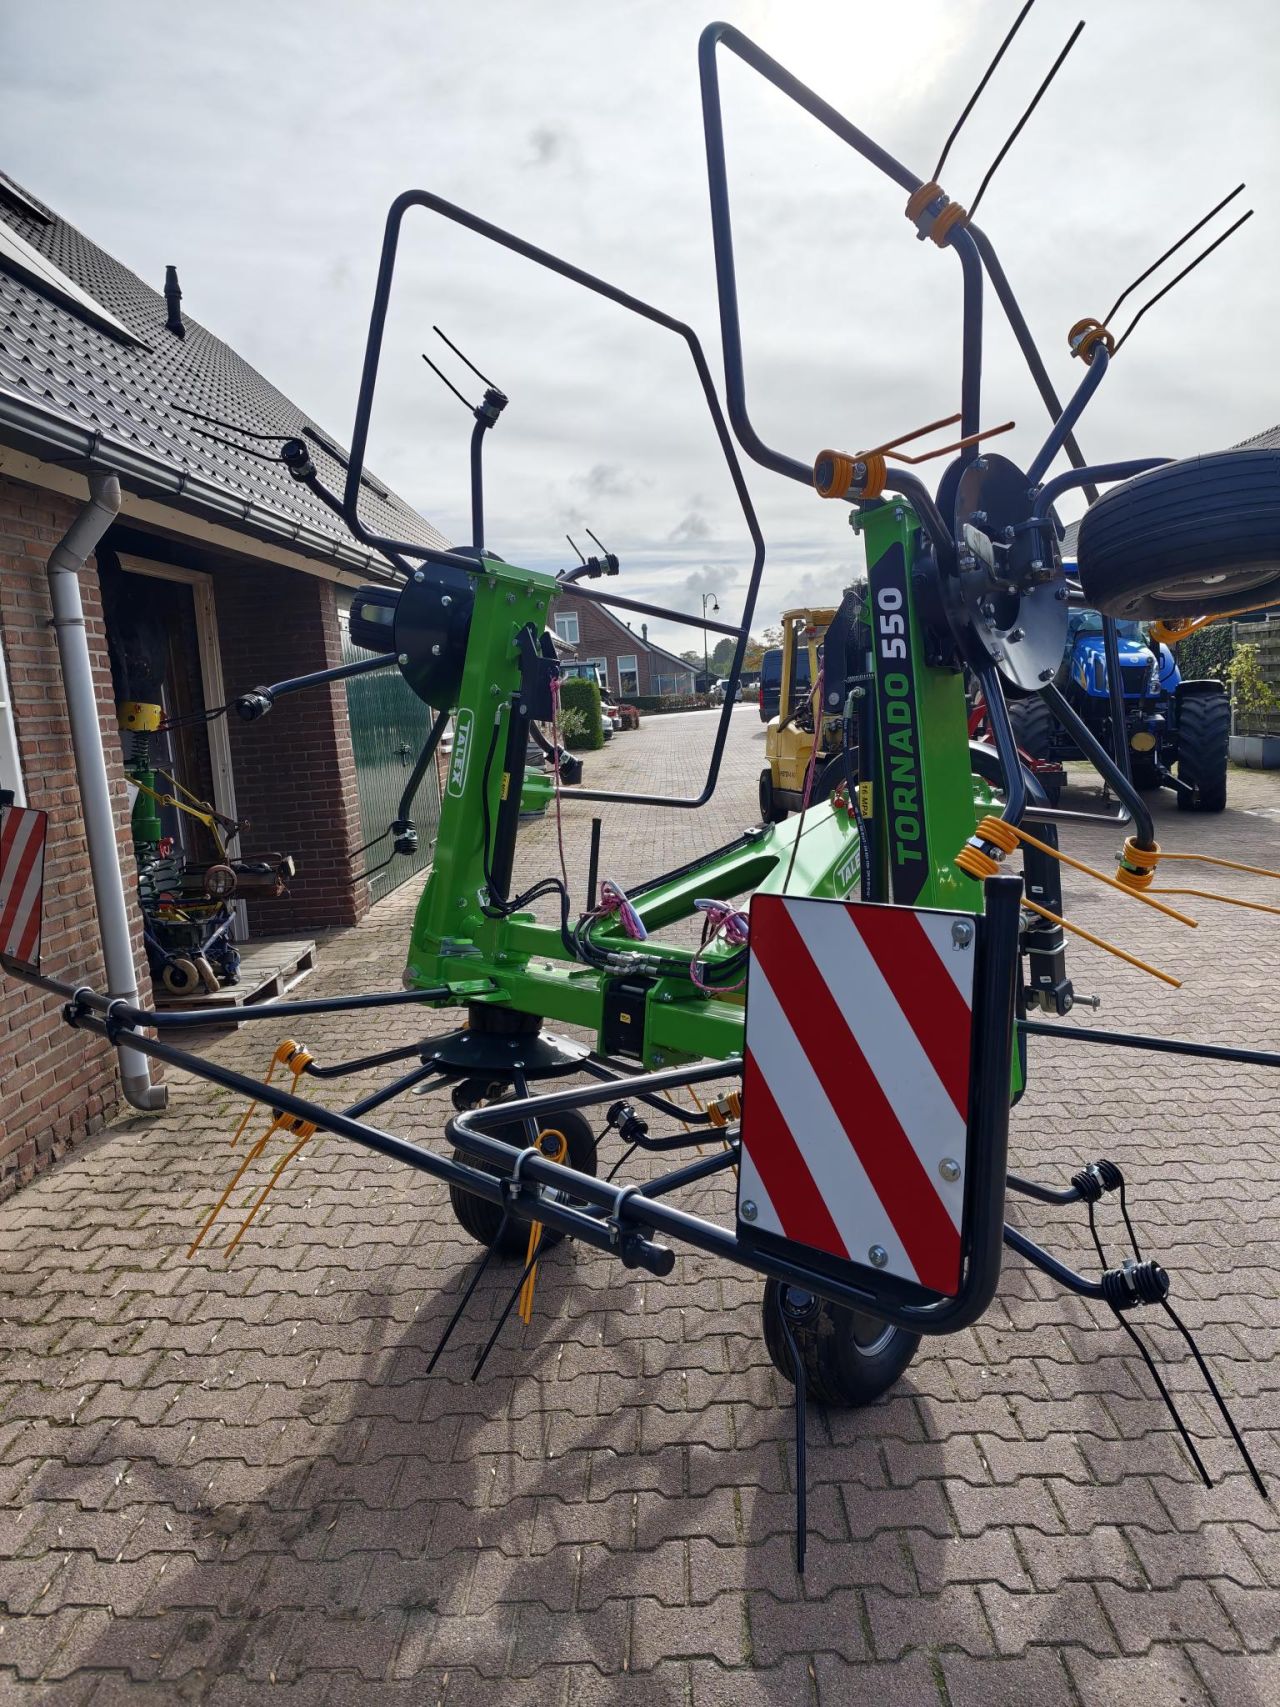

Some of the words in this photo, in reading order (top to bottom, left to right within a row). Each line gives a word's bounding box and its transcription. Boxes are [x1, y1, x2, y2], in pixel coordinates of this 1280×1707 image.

[878, 587, 907, 659] 550
[451, 719, 471, 788] TALEX
[884, 672, 922, 864] TORNADO
